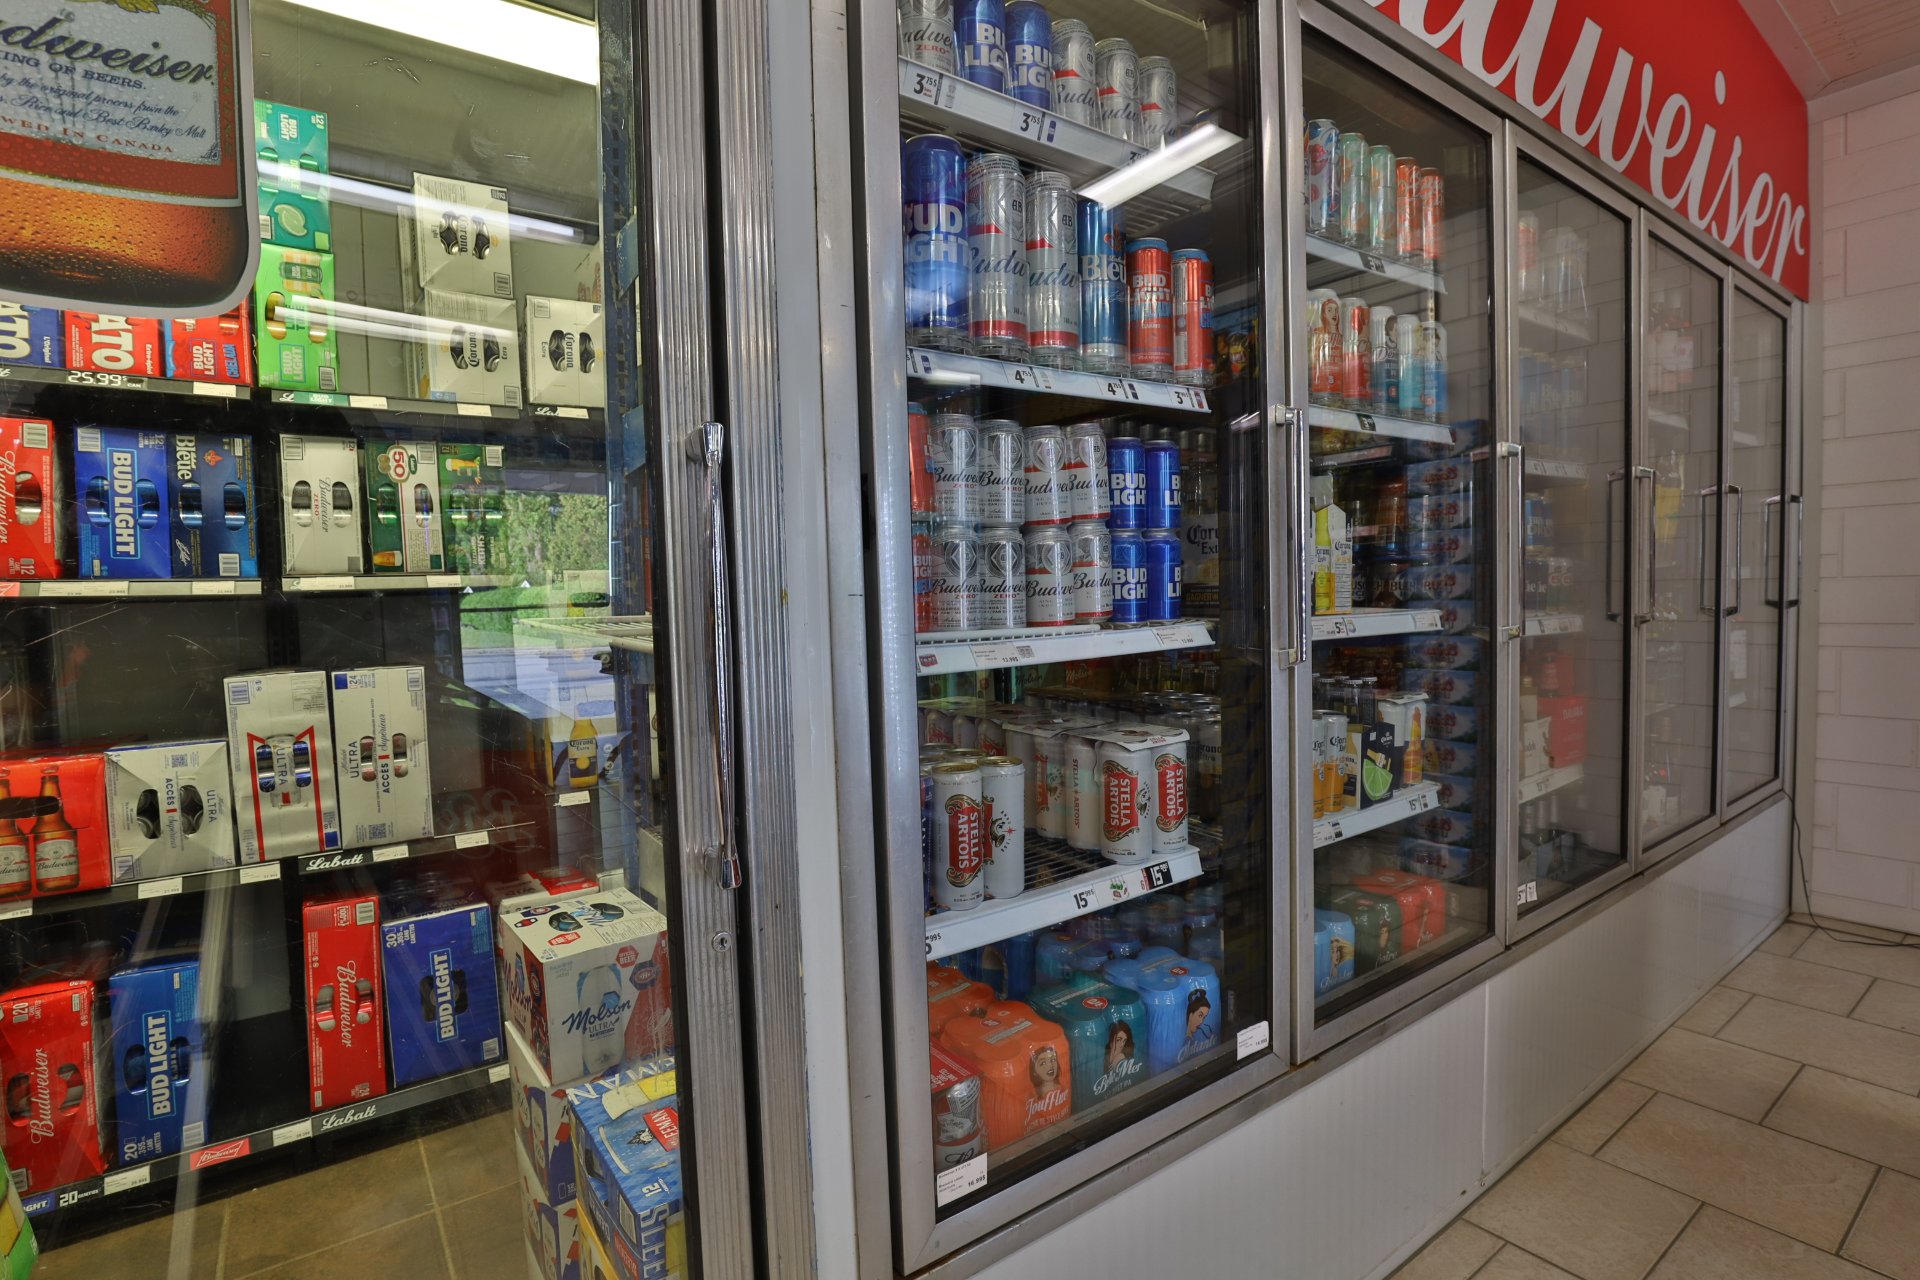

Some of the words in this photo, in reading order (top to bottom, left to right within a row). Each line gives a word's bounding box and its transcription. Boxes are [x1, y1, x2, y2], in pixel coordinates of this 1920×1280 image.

[2, 52, 40, 68] ING
[48, 61, 77, 76] OF
[1015, 44, 1052, 67] BU
[913, 72, 926, 95] 3
[1005, 65, 1052, 89] LIG
[19, 76, 42, 91] the
[91, 91, 135, 113] process
[175, 124, 207, 139] Malt
[279, 113, 289, 141] LIGHT
[288, 117, 298, 139] BUD
[1019, 112, 1031, 132] 3
[62, 127, 85, 138] IN
[96, 134, 175, 153] CANADA
[907, 234, 969, 263] GHT
[1029, 262, 1080, 289] udw
[1132, 273, 1167, 287] BUD
[193, 344, 203, 371] BUD
[203, 341, 215, 377] LIGHT
[563, 331, 575, 369] Corona
[1014, 369, 1025, 384] 4
[1107, 382, 1116, 396] 4
[1174, 390, 1184, 405] 3
[176, 434, 197, 480] Bleue
[391, 450, 406, 479] 50
[112, 452, 133, 495] BUD
[318, 476, 330, 533] Budweiser
[1109, 489, 1147, 506] LIGH
[114, 496, 135, 556] LIGHT
[1110, 583, 1148, 600] LIGH
[1065, 669, 1089, 682] Molson
[275, 747, 288, 787] ULTRA
[350, 740, 360, 779] ULTRA
[165, 777, 175, 806] ACCÈS
[381, 762, 391, 794] ACCÈS
[1175, 768, 1185, 816] STELLA
[206, 789, 217, 823] ULTRA
[1109, 776, 1120, 827] ARTOIS
[1119, 778, 1132, 828] STELLA
[1165, 770, 1176, 818] ARTOIS
[957, 813, 970, 869] ARTOIS
[969, 811, 980, 867] STELLA
[306, 852, 364, 872] Labatt
[1150, 865, 1163, 887] 15
[1073, 892, 1089, 910] 15
[386, 933, 398, 949] 30
[433, 952, 455, 1005] LIGHT
[336, 960, 357, 1049] Budweiser
[561, 998, 632, 1035] Molson
[437, 1003, 456, 1040] BUD
[148, 1014, 168, 1070] LIGHT
[1115, 1058, 1143, 1080] Mer
[30, 1047, 55, 1144] Budweiser
[150, 1071, 171, 1117] BUD
[321, 1104, 377, 1131] Labatt
[124, 1142, 138, 1161] 20
[967, 1174, 986, 1188] 16.99$
[59, 1190, 79, 1207] 20
